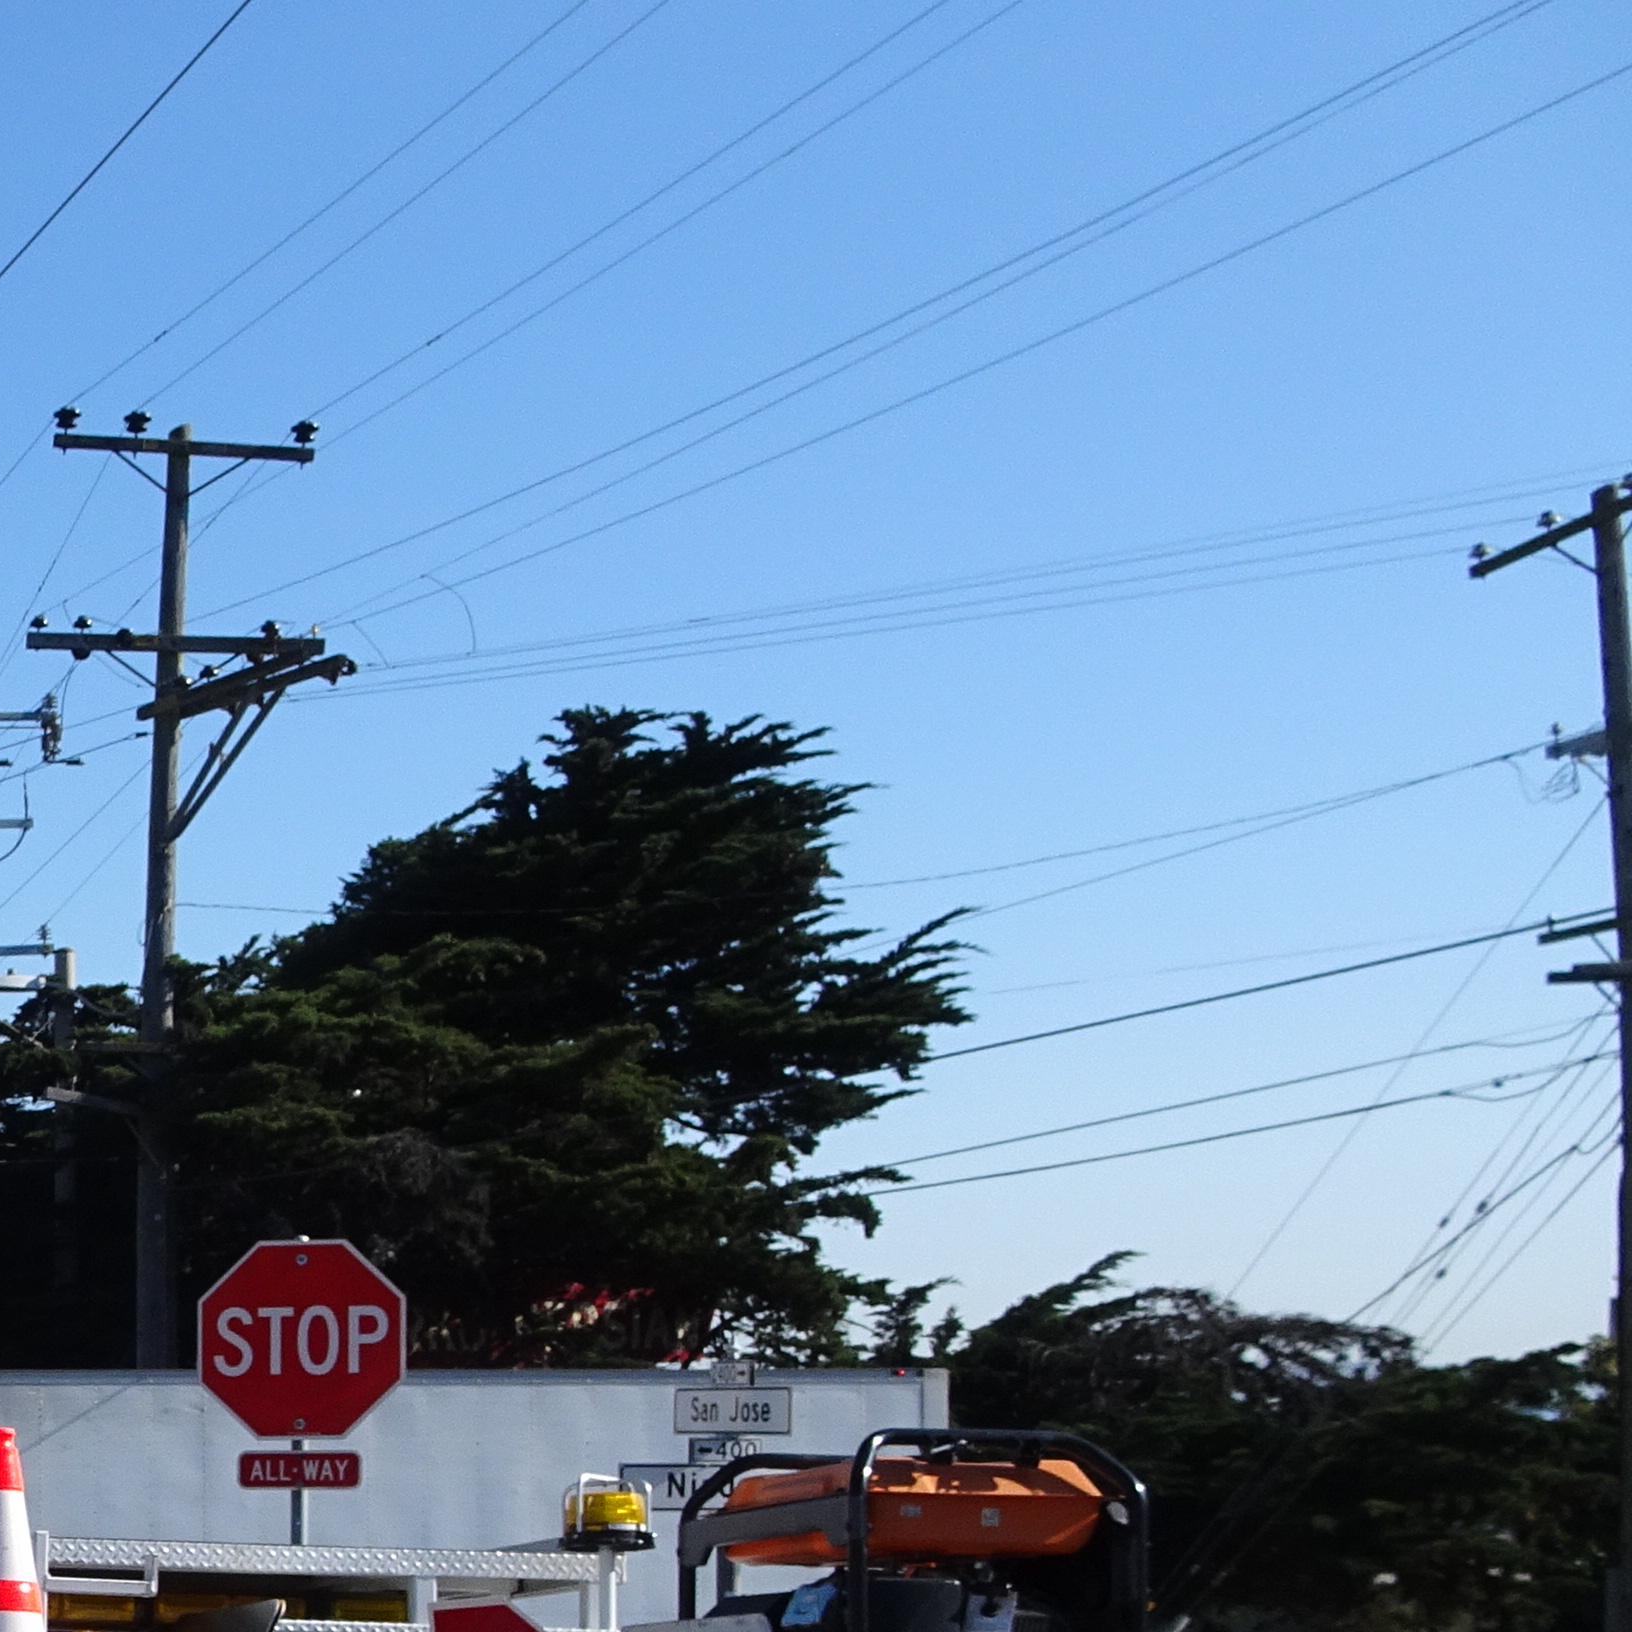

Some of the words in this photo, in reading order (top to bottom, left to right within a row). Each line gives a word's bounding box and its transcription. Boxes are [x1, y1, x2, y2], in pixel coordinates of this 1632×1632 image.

[213, 1305, 390, 1377] STOP
[691, 1396, 718, 1422] San
[729, 1396, 771, 1422] Jose
[716, 1441, 757, 1459] 400
